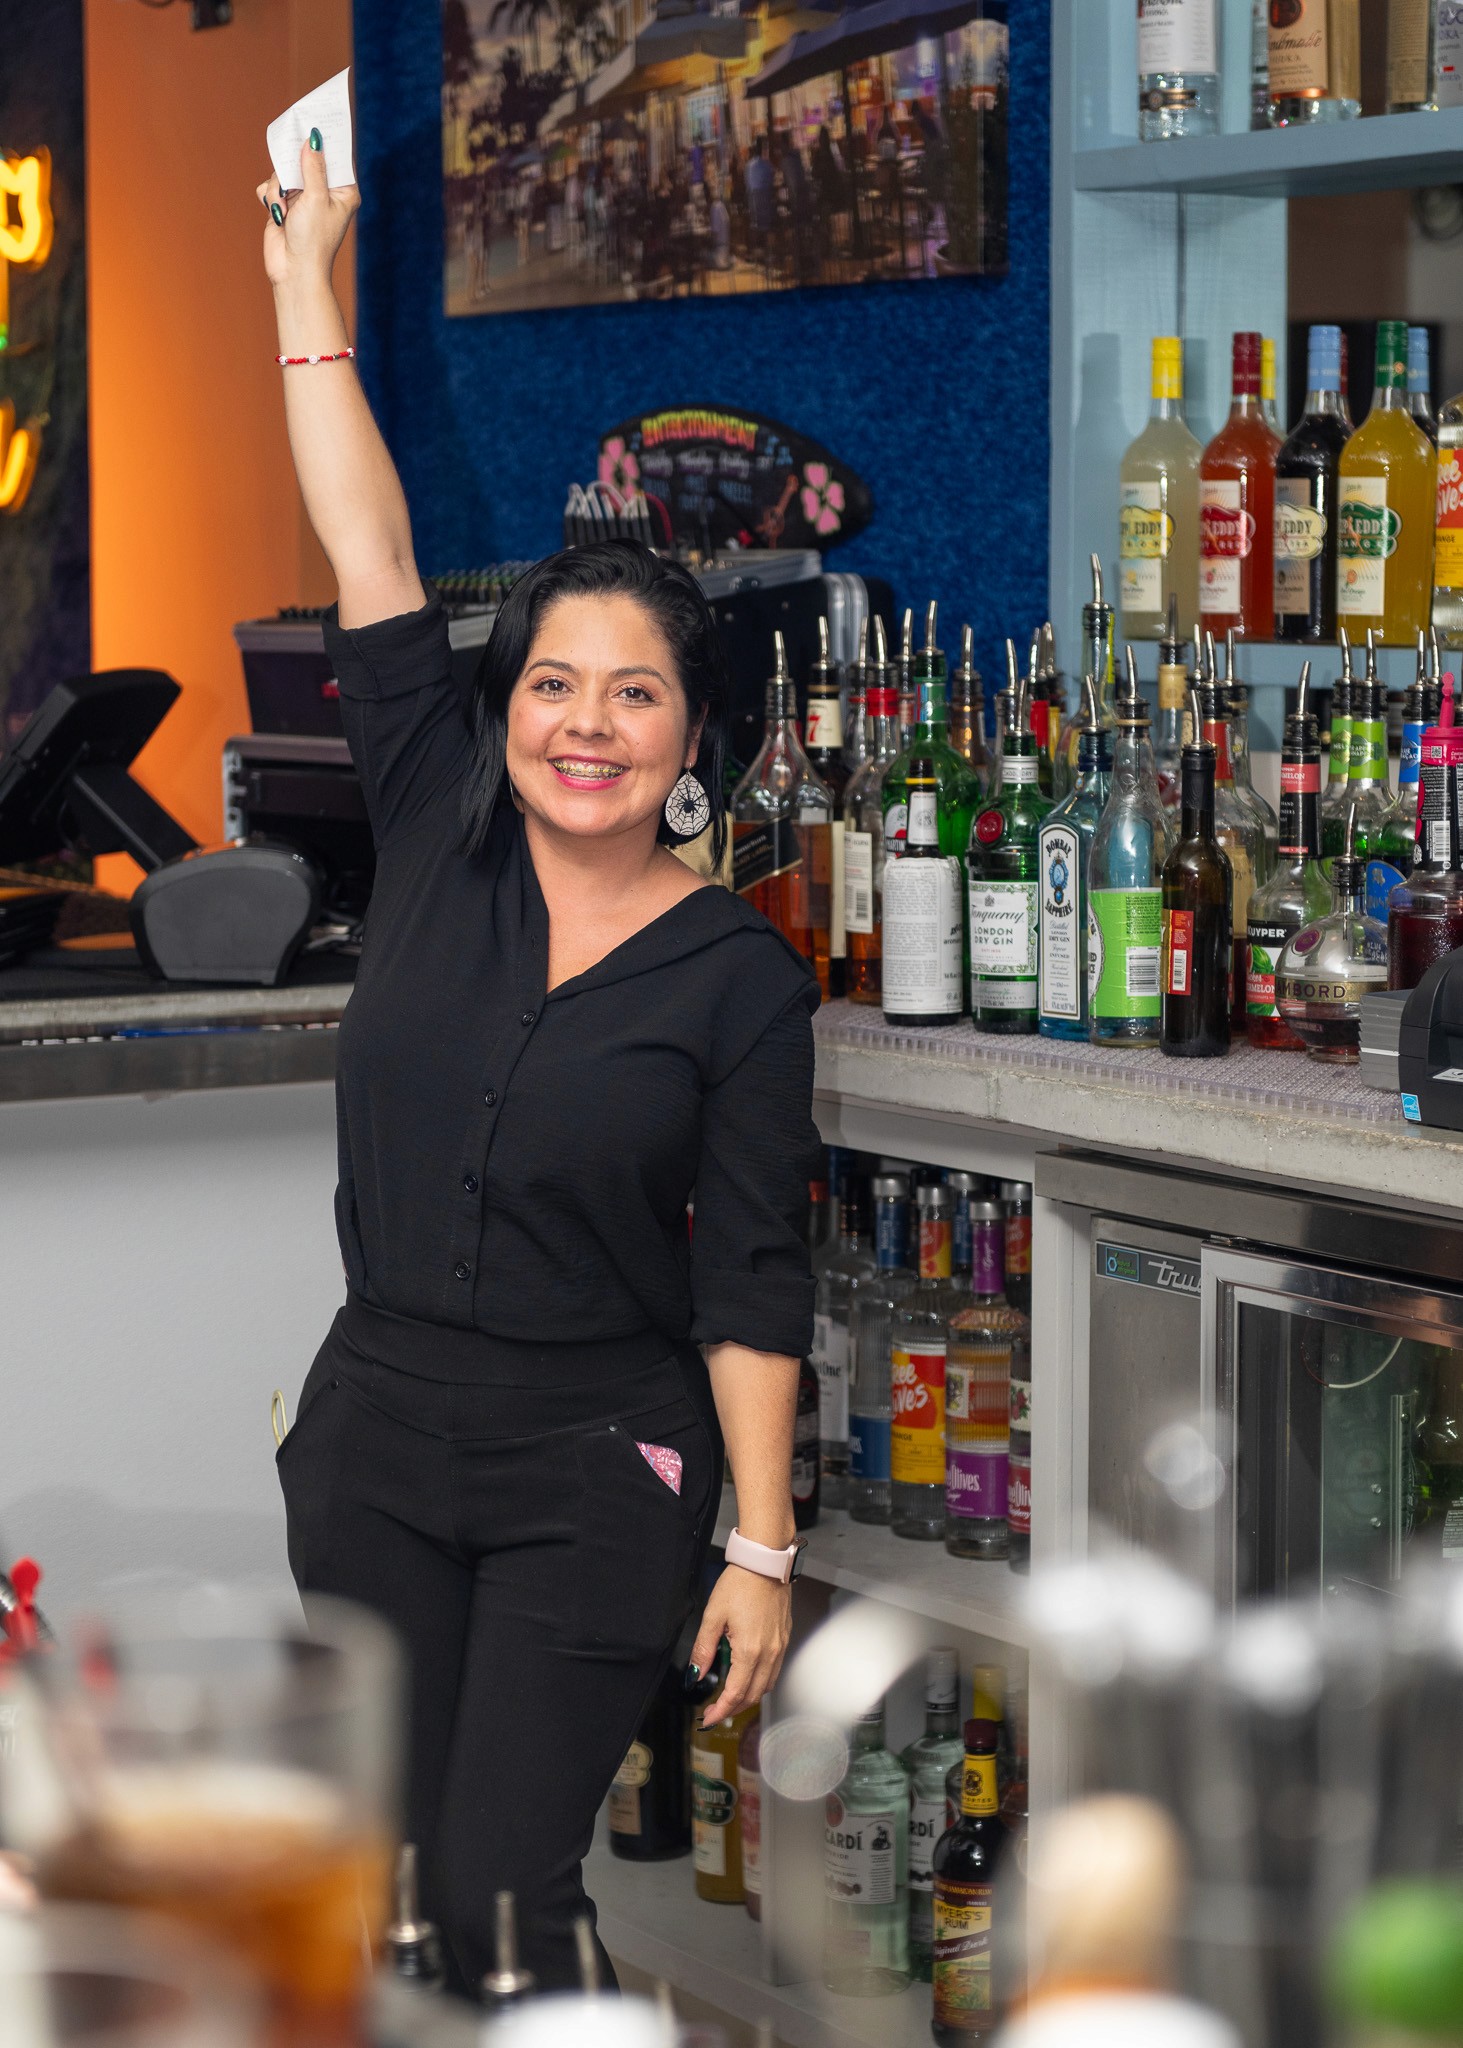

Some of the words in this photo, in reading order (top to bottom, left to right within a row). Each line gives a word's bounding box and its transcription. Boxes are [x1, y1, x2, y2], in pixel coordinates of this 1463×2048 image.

[1284, 520, 1312, 534] EDDY
[808, 715, 821, 743] 7
[1045, 838, 1072, 858] BOMBAY
[1045, 898, 1074, 918] SAPPHIRE
[974, 926, 1014, 936] LONDON
[974, 935, 990, 944] DRY
[992, 937, 1014, 946] GIN
[944, 1917, 969, 1930] RUM
